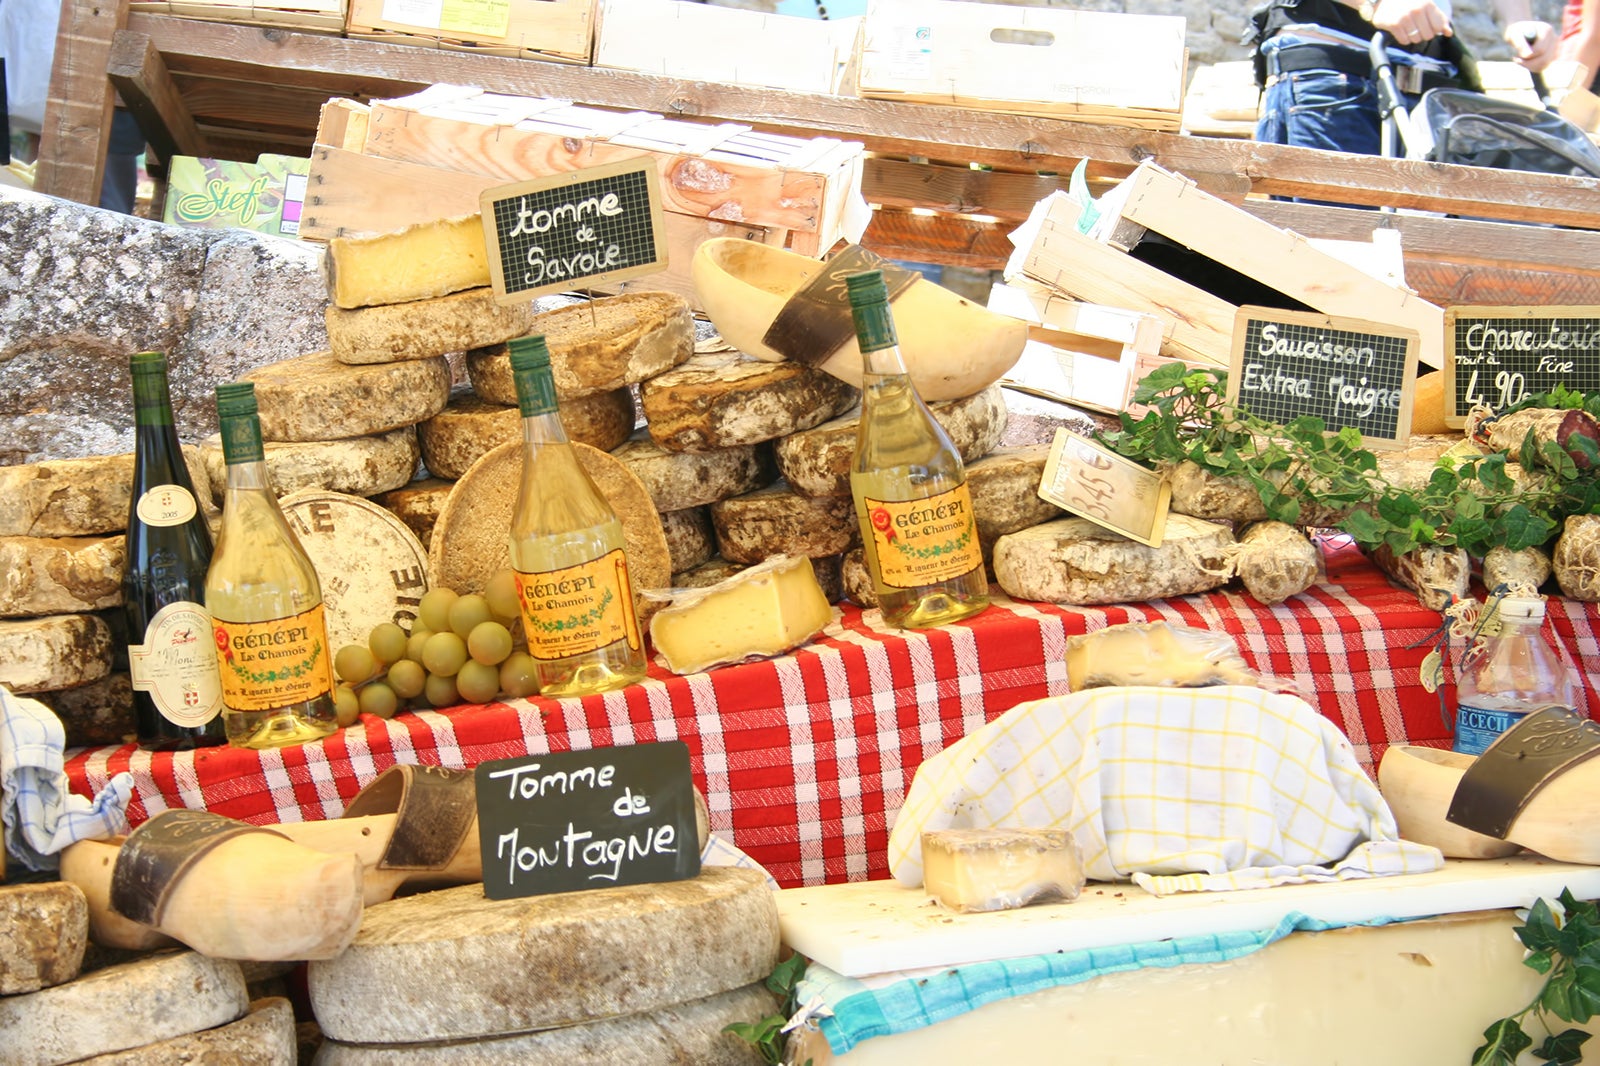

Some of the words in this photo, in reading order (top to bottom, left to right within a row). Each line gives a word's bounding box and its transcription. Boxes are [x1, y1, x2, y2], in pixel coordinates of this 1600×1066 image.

[509, 193, 624, 237] tomme
[576, 224, 597, 243] de
[524, 240, 624, 284] Savoie
[1259, 324, 1374, 368] Saucisson
[1536, 355, 1574, 373] Fine
[1243, 363, 1312, 399] Extra
[922, 519, 965, 536] Chamois
[532, 601, 544, 611] Le
[546, 594, 594, 610] Chamois
[240, 652, 255, 662] Le
[258, 646, 307, 660] Chamois
[489, 763, 615, 800] Tomme
[613, 787, 650, 816] de
